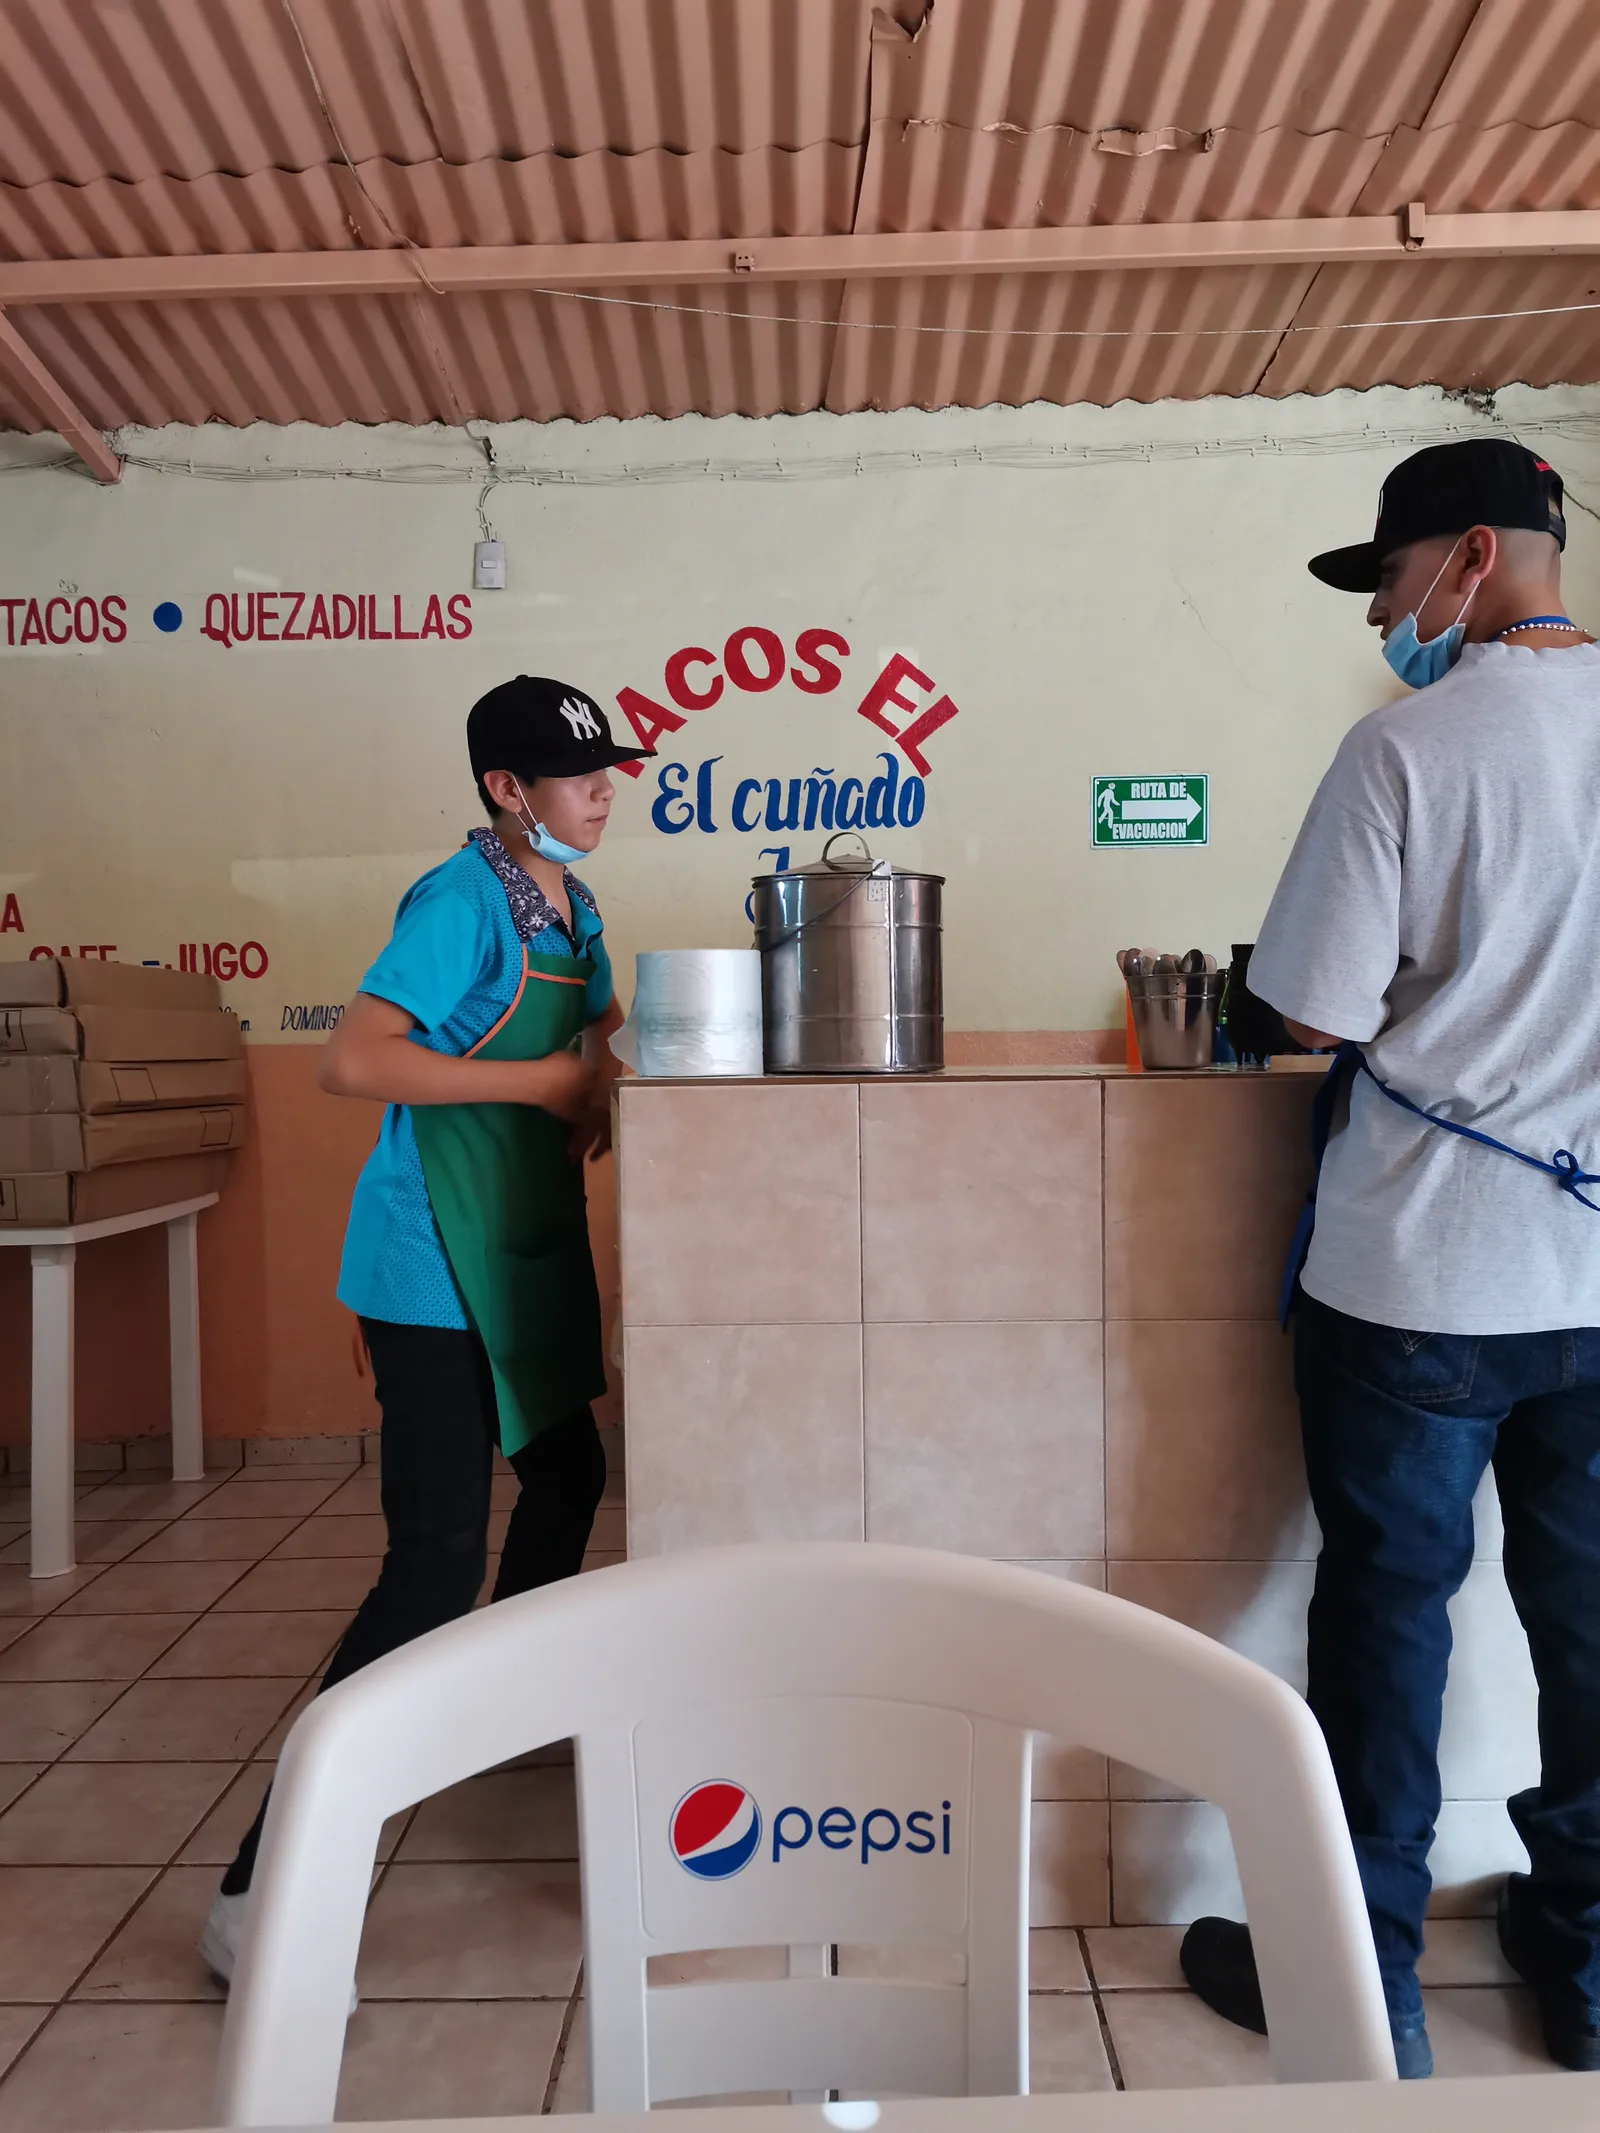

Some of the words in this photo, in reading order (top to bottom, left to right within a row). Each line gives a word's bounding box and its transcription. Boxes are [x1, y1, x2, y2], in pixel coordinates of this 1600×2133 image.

[0, 595, 127, 646] TACOS
[200, 591, 473, 648] QUEZADILLAS
[609, 626, 851, 779] ACOS
[857, 652, 959, 778] EL
[651, 755, 724, 834] El
[731, 752, 926, 833] cuñado
[1131, 782, 1167, 799] RUTA
[1169, 781, 1187, 798] DE
[1112, 822, 1187, 840] EVACUACION
[772, 1800, 952, 1865] pepsi
